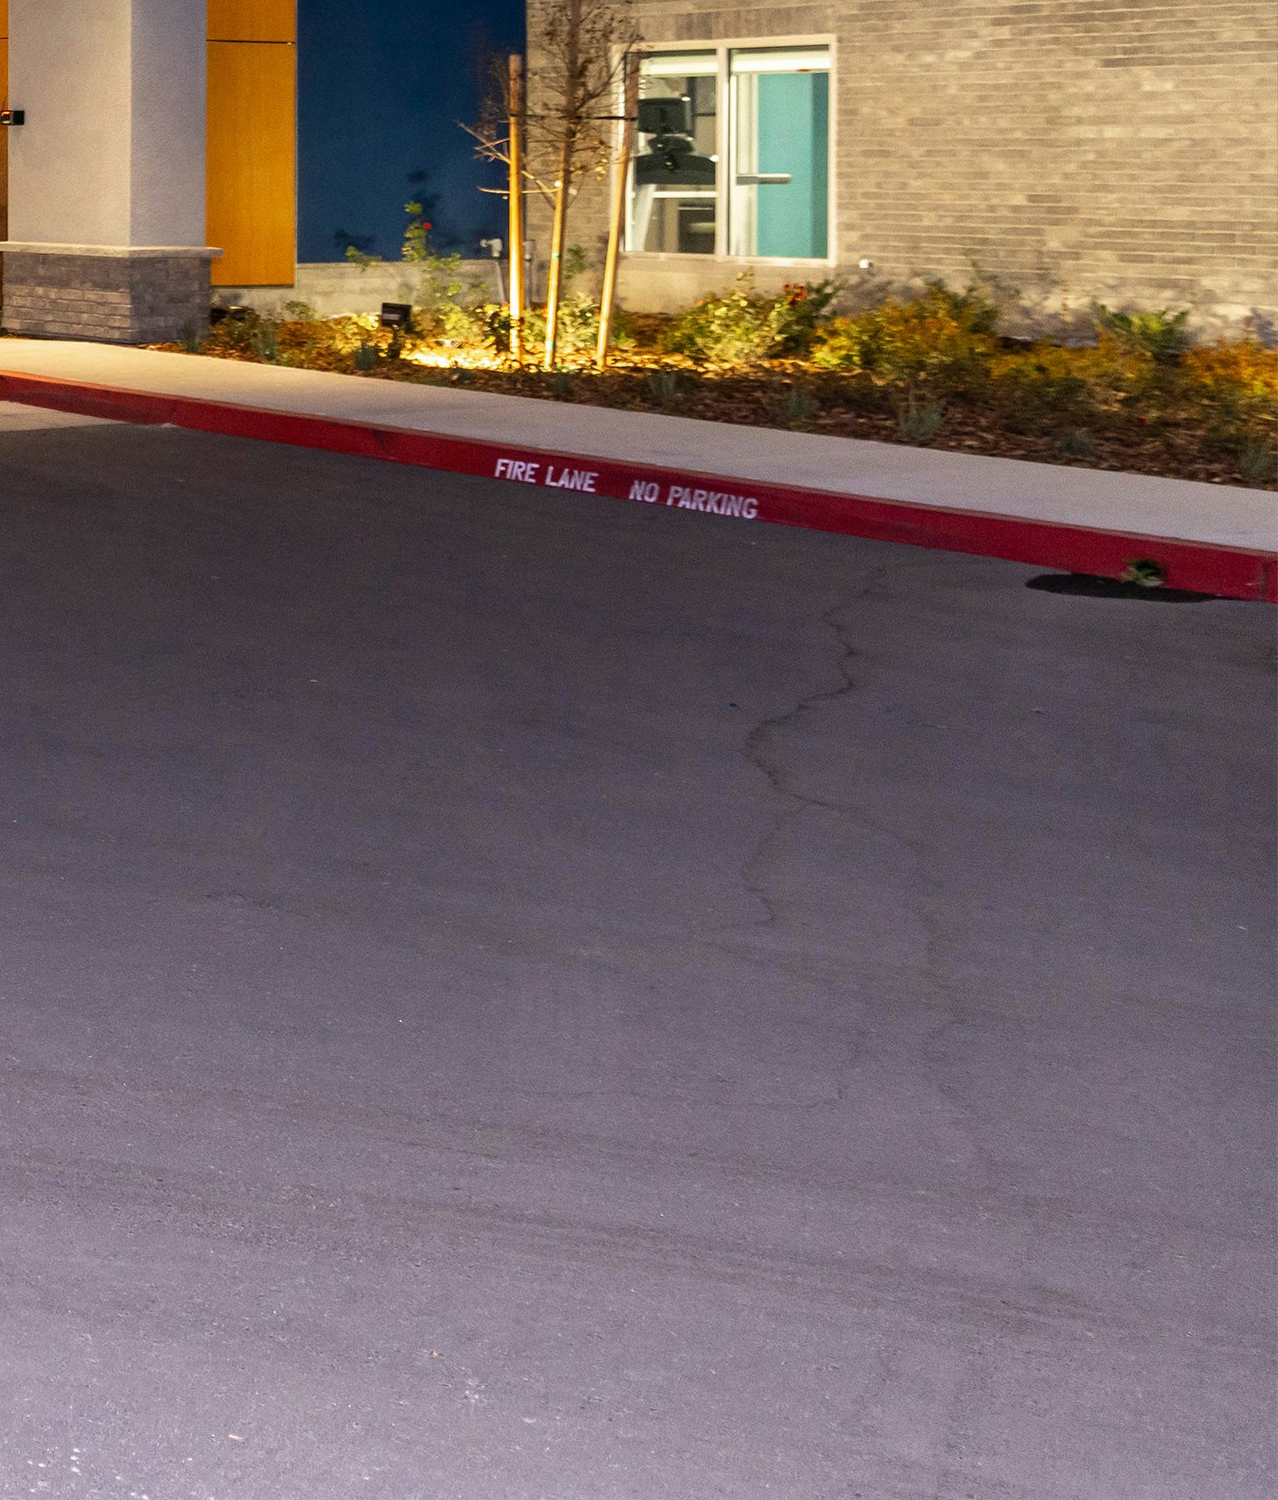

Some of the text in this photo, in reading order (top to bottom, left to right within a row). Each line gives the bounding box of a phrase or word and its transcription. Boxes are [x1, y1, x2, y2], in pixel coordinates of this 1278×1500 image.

[494, 458, 759, 519] FIRE LANE NO PARKING
